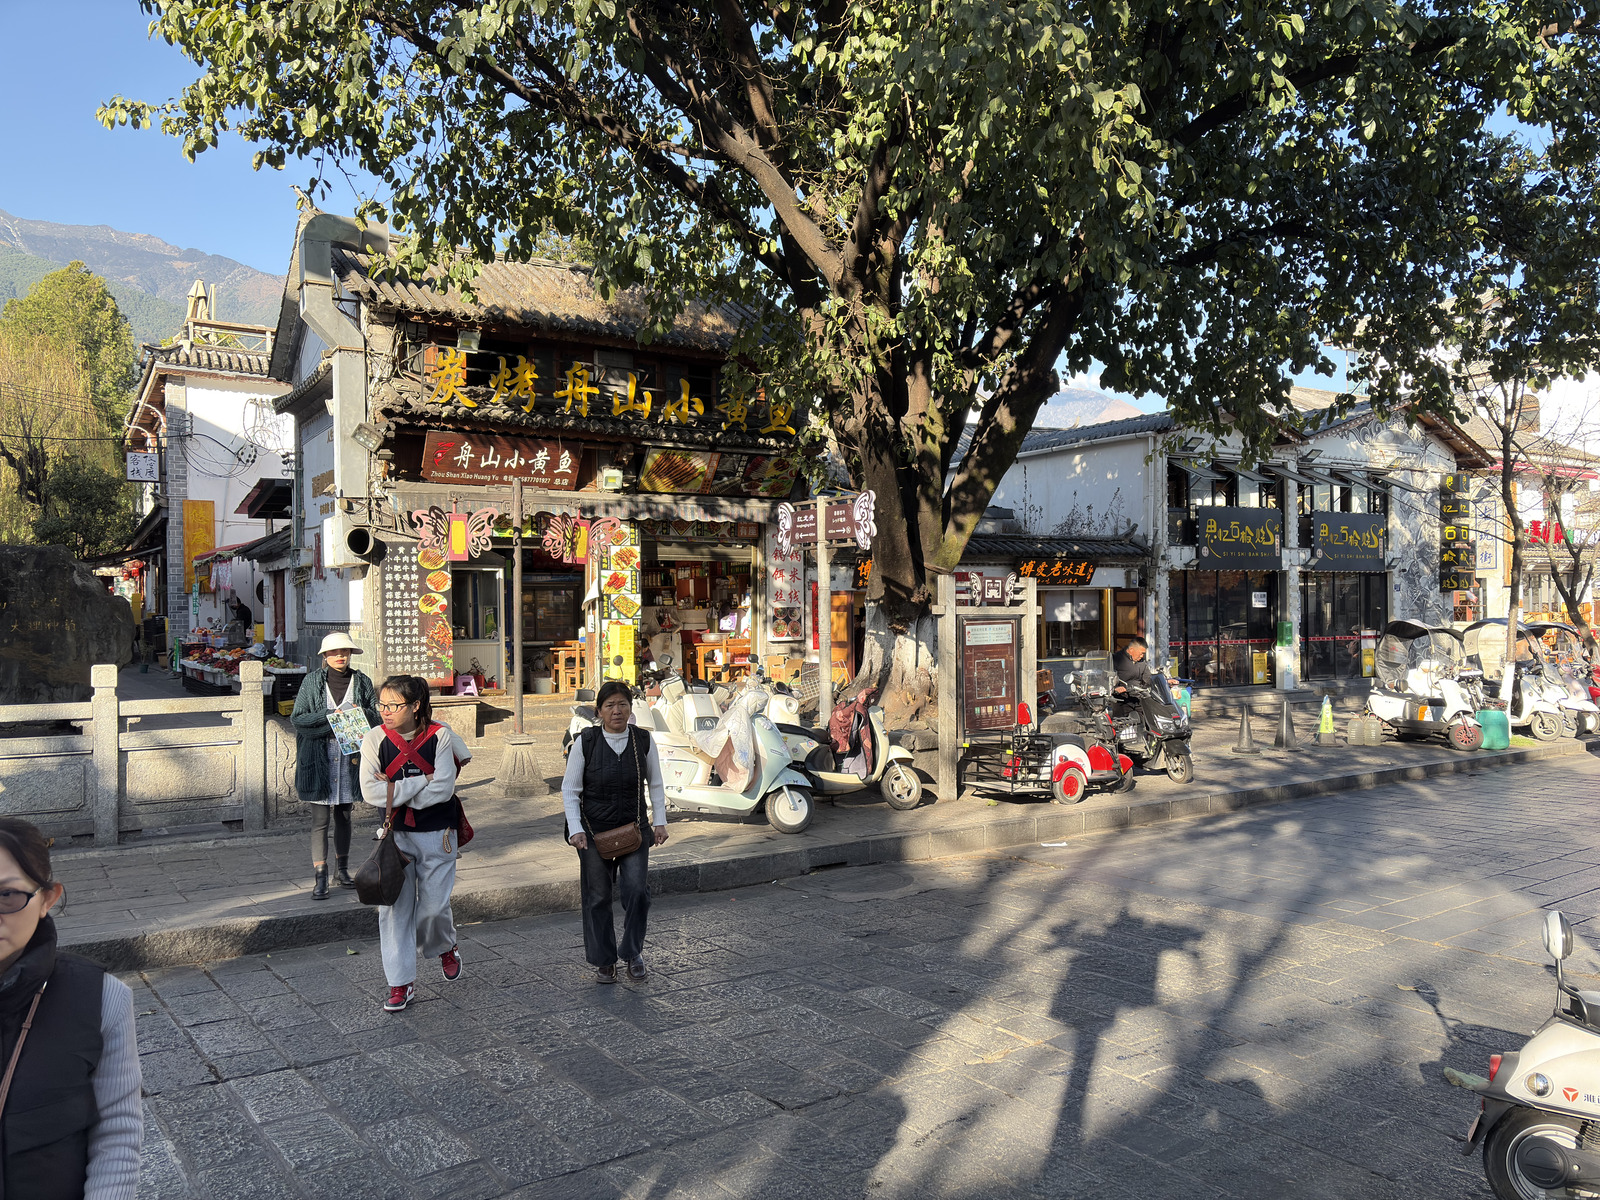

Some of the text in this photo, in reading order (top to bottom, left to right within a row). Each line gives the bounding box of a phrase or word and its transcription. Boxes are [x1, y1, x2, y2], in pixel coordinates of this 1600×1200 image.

[429, 347, 796, 435] 炭烤舟山小黄鱼
[454, 441, 572, 475] 舟山小黄鱼
[385, 546, 418, 554] 小黄鱼
